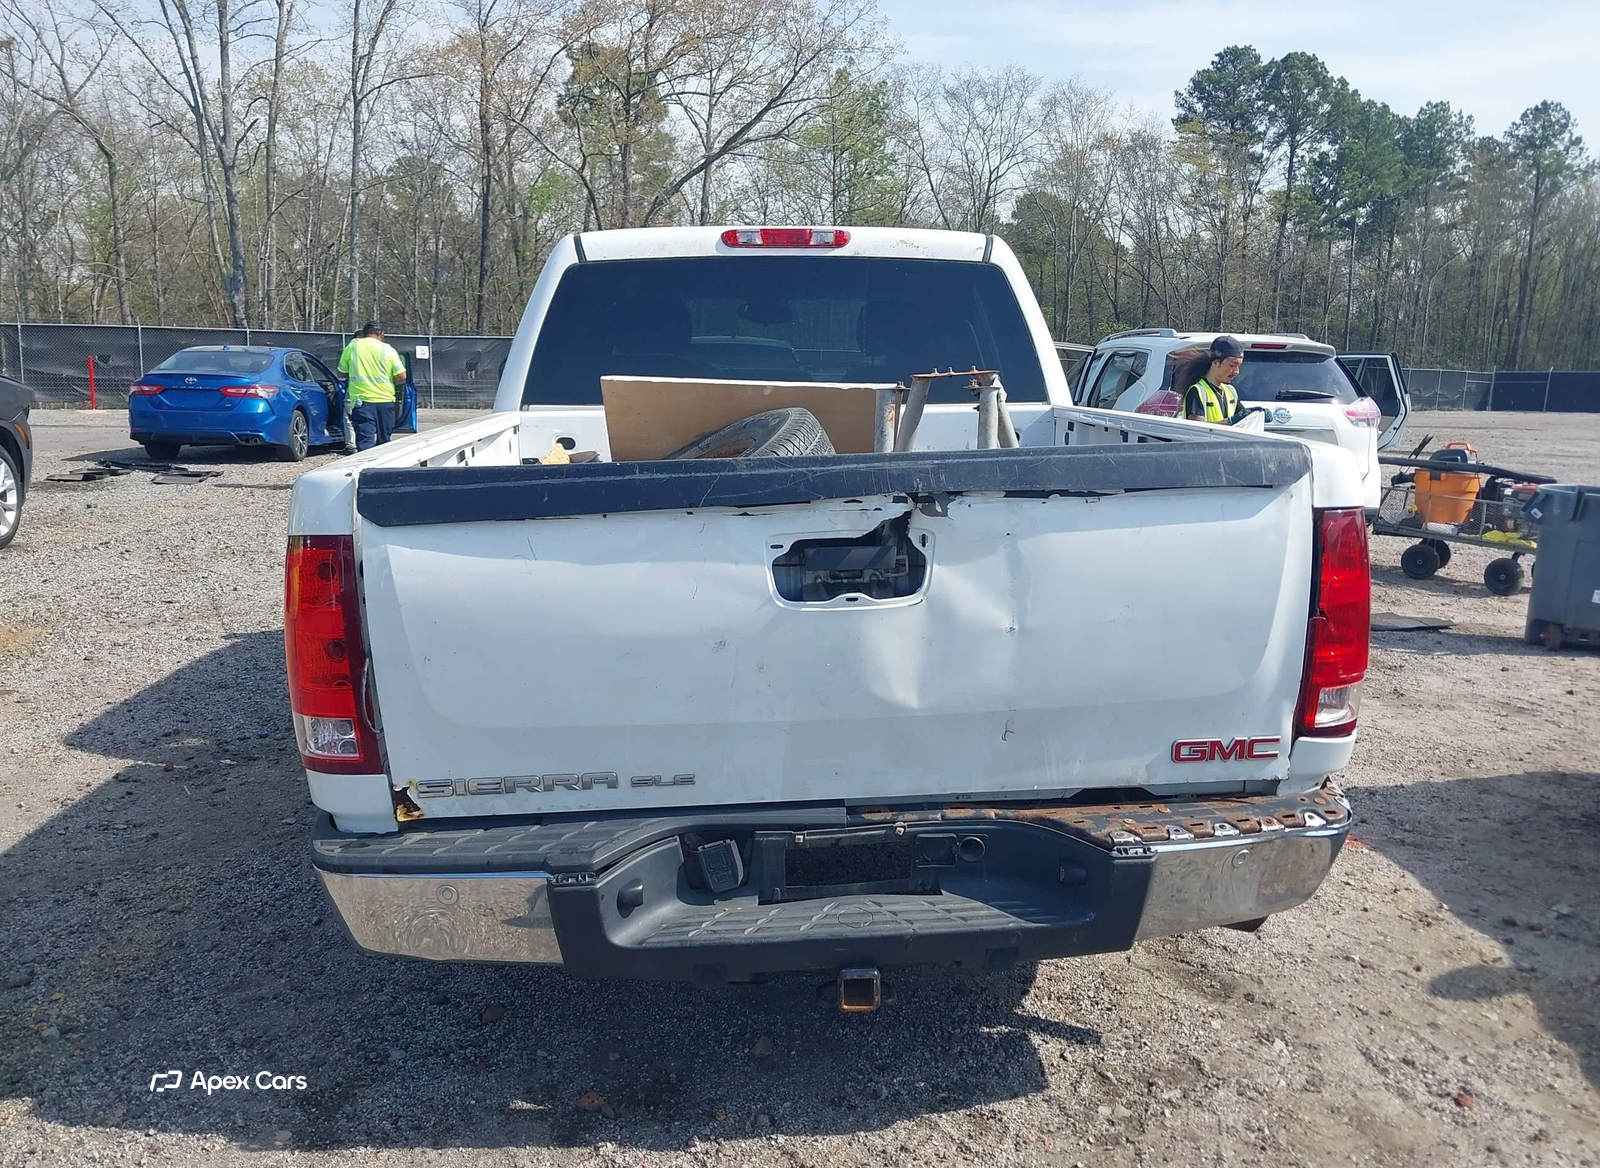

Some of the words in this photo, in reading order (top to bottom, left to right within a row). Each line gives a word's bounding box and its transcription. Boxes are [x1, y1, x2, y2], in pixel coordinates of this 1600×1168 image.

[1171, 736, 1281, 763] GMC
[416, 772, 618, 798] SIERRA
[630, 774, 696, 787] SLE
